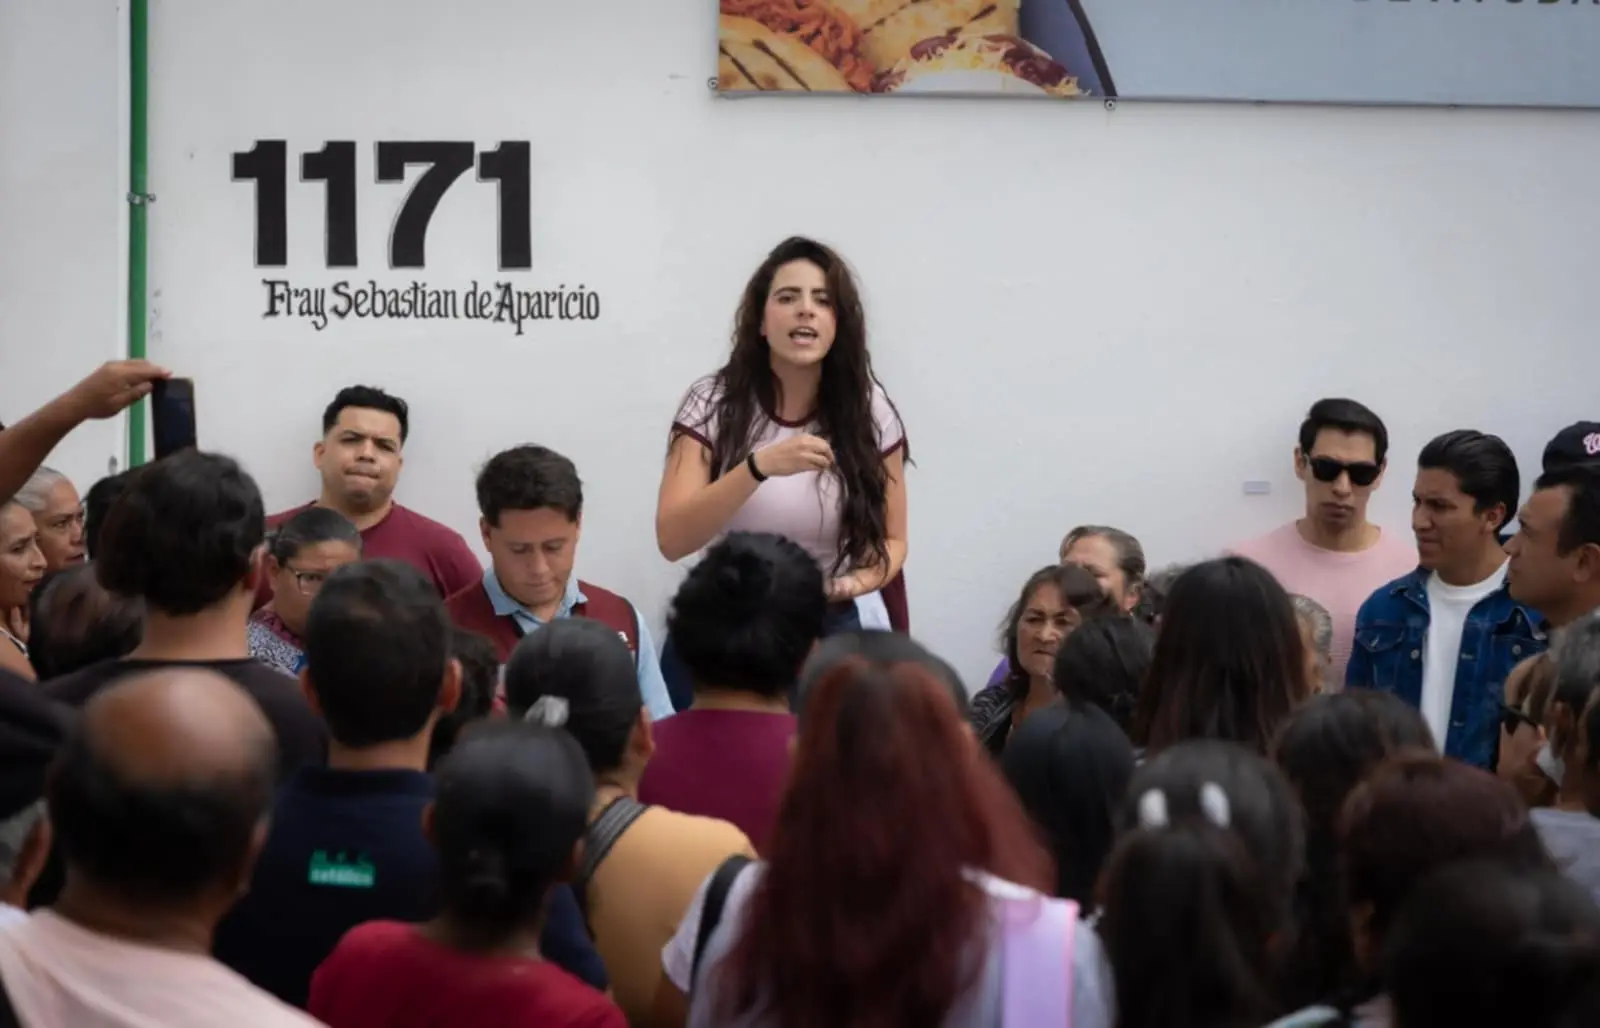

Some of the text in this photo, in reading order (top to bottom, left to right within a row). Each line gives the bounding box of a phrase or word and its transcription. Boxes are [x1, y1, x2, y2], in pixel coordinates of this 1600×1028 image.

[231, 139, 532, 271] 1171
[261, 279, 601, 336] Fray Sebastian de Aparicio
